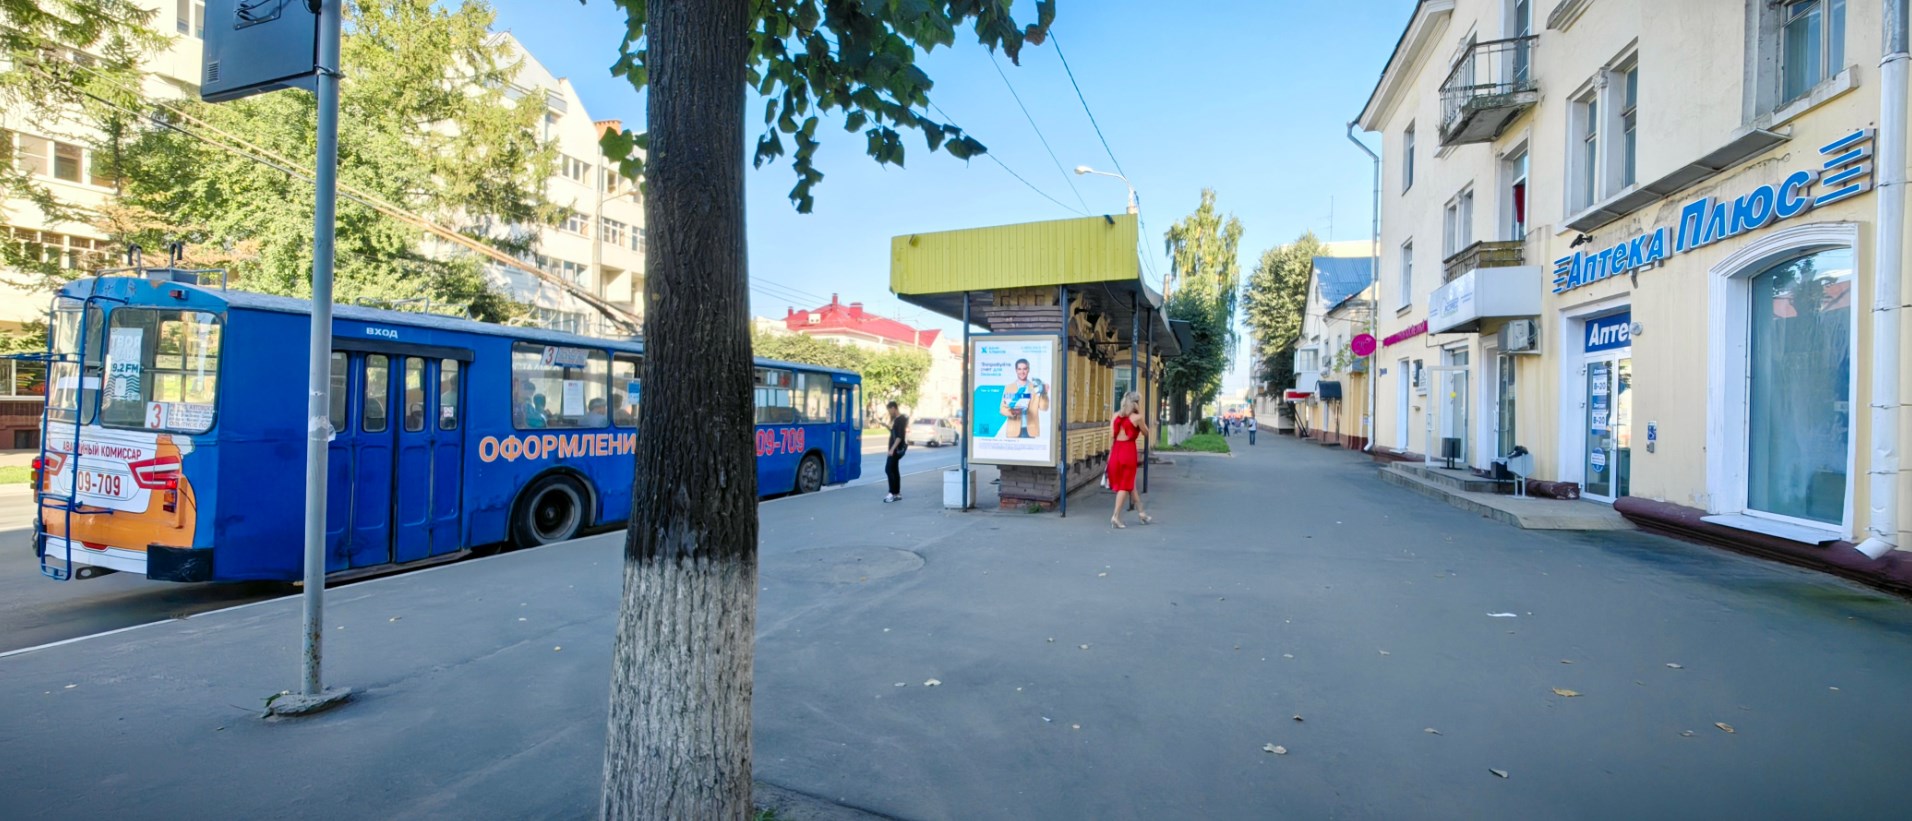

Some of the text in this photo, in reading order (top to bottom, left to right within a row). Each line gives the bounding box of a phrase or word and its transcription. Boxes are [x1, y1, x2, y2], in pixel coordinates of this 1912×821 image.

[1588, 321, 1632, 347] Апте
[545, 346, 555, 364] 3
[150, 403, 161, 429] 3
[100, 445, 142, 460] КОМИССАР
